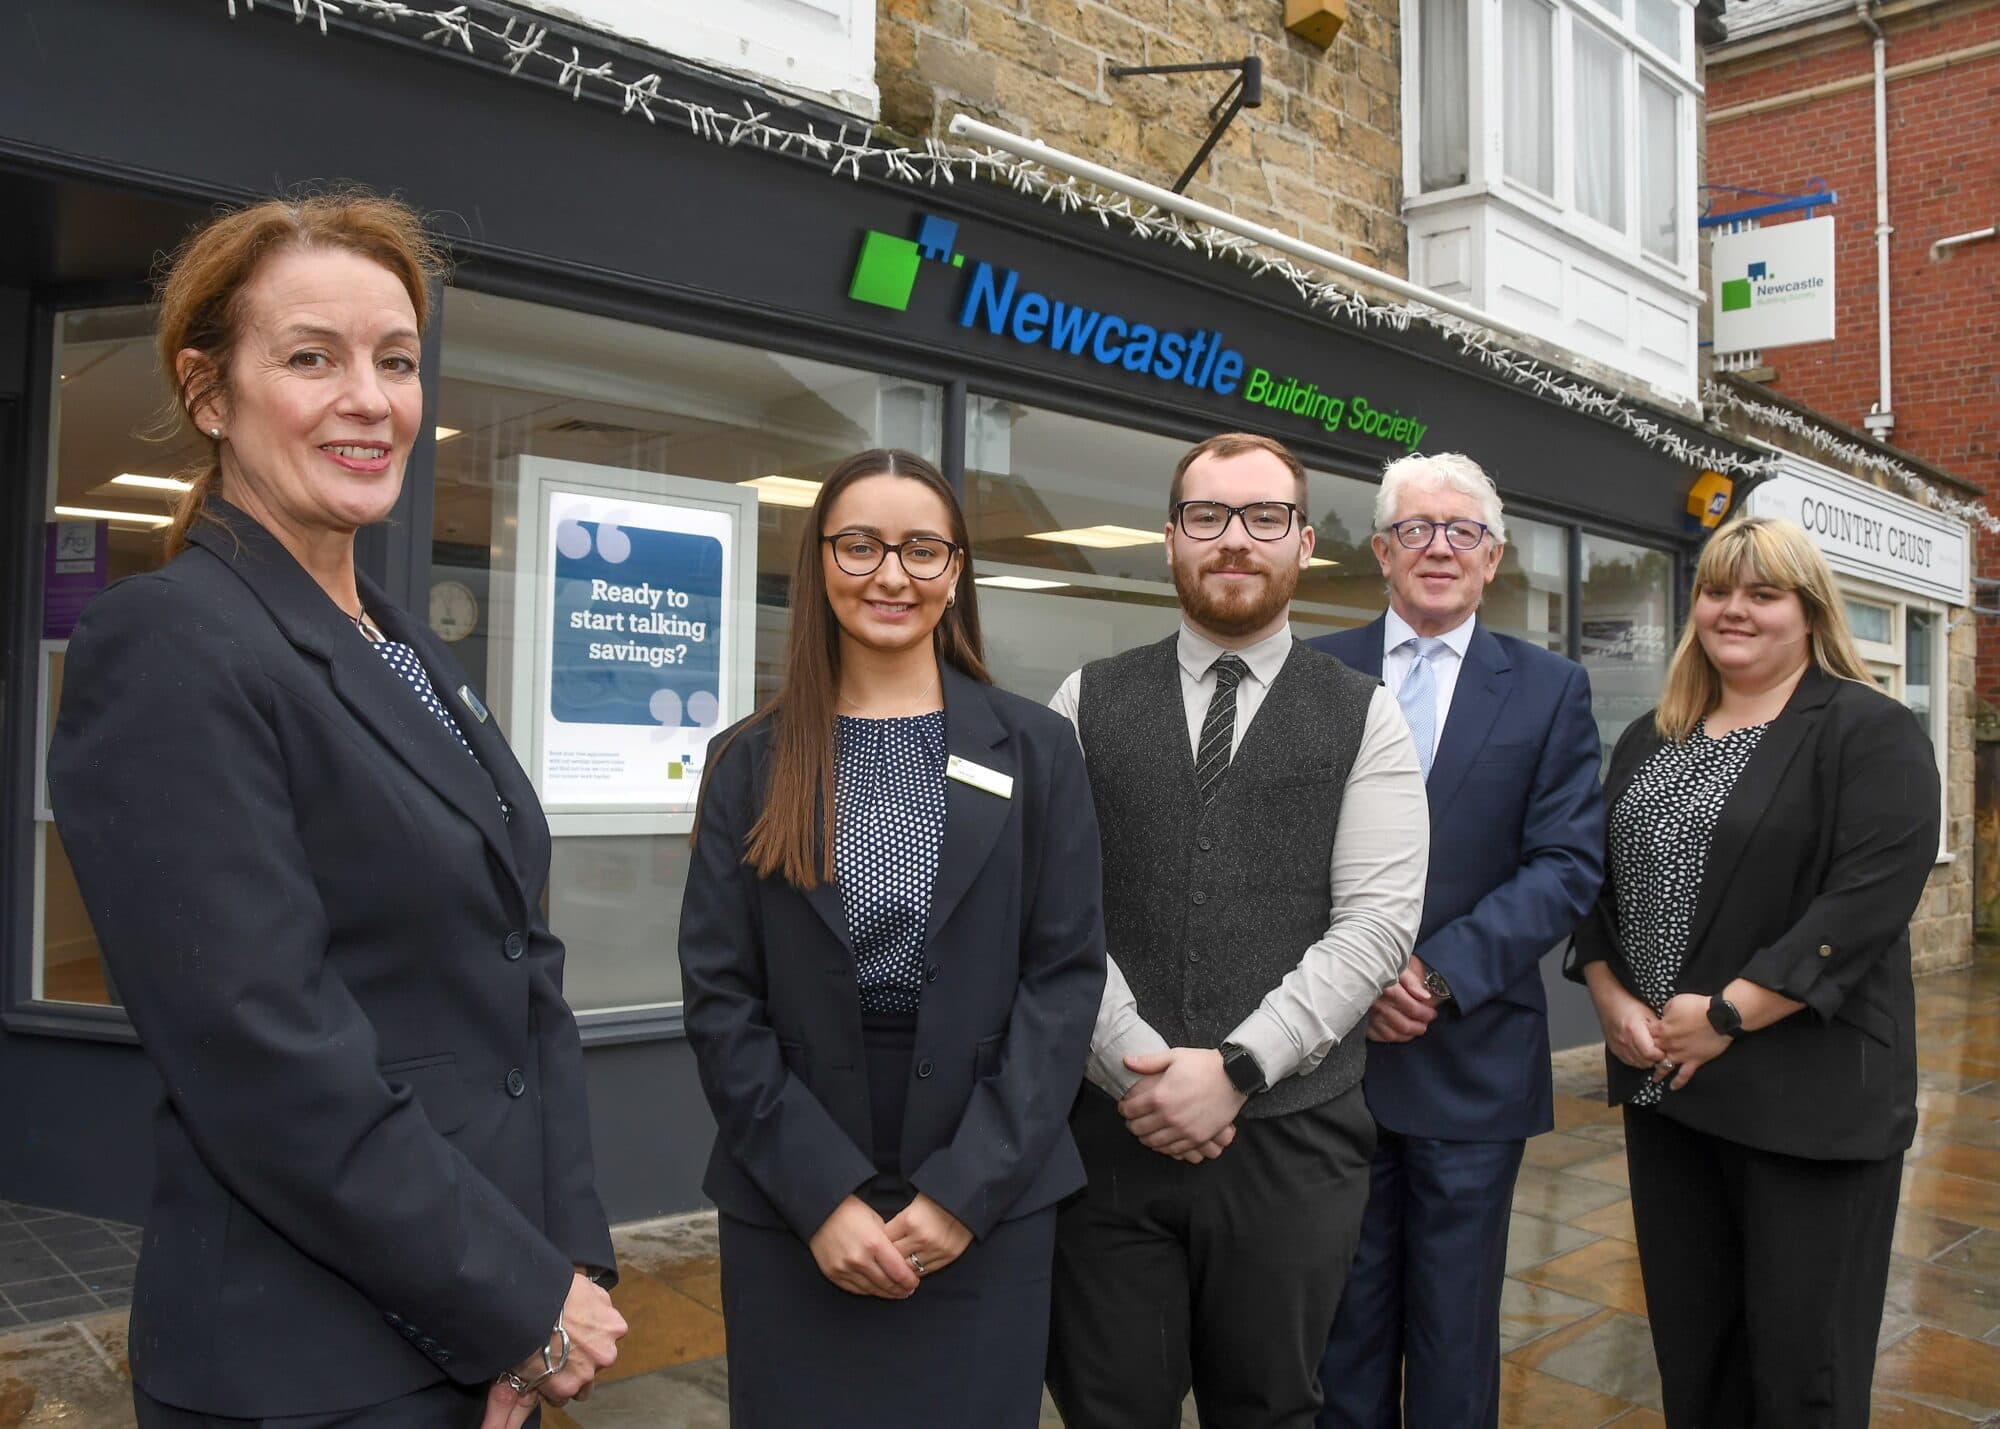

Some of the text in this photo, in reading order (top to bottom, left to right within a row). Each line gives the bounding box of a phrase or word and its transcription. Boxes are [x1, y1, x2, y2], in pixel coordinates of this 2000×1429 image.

[1757, 277, 1824, 296] Newcastle
[961, 262, 1427, 450] Newcastle Building Society
[1801, 496, 1932, 568] COUNTRY CRUST
[591, 579, 689, 609] Ready to
[570, 610, 706, 642] start talking
[589, 640, 687, 668] savings?
